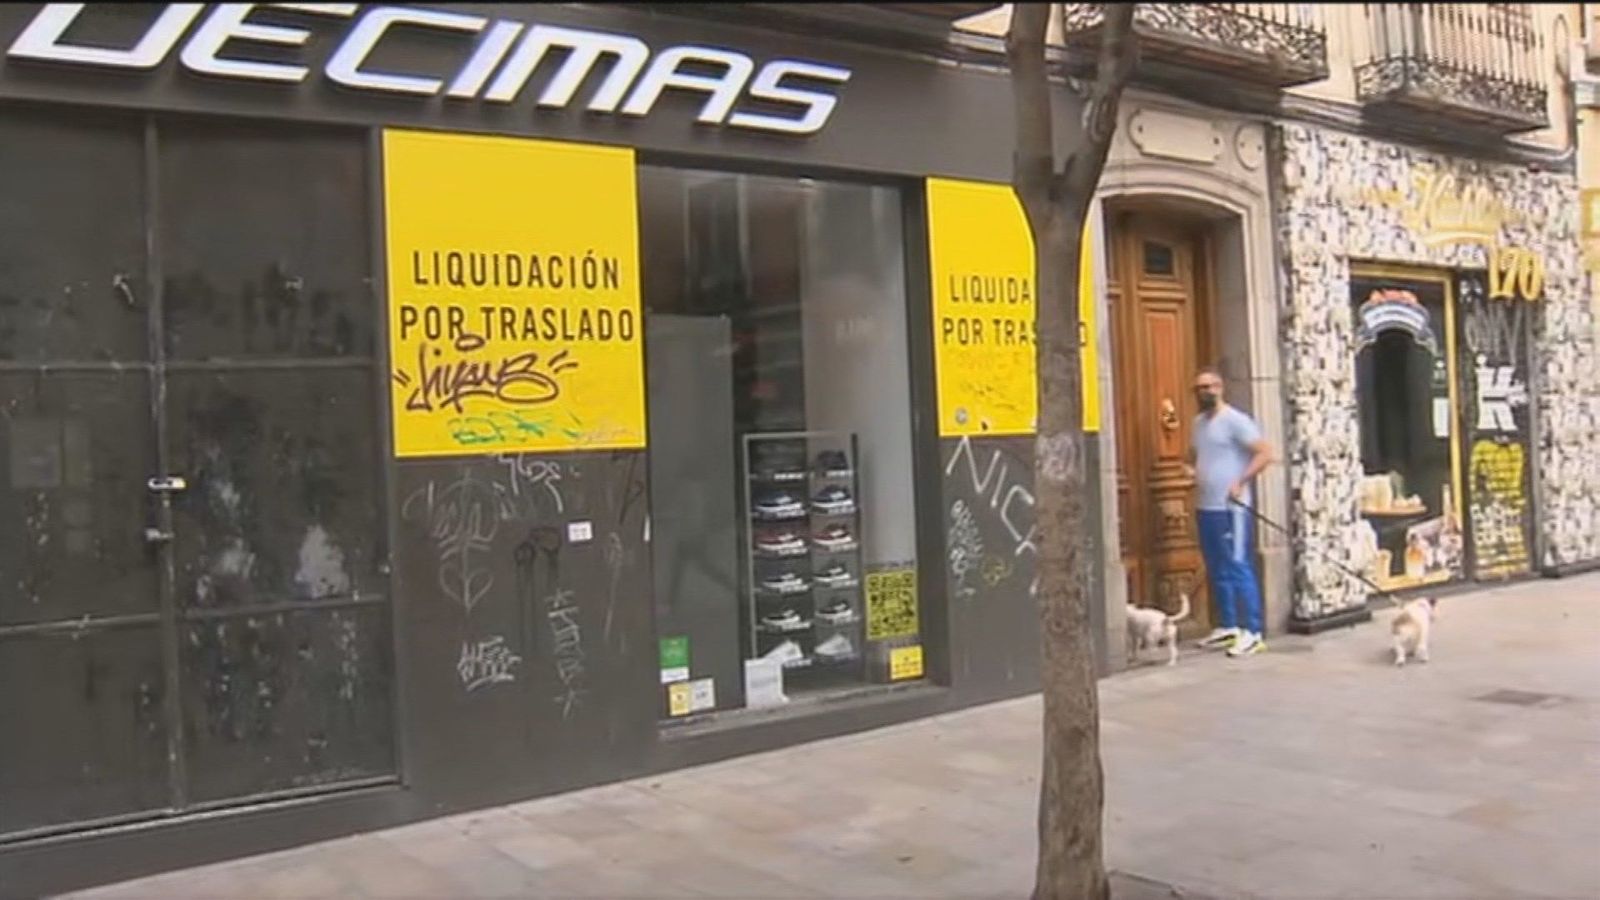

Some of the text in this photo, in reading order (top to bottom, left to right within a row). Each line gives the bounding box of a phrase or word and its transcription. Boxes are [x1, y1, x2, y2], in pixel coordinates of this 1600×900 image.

[6, 4, 851, 135] DECIMAS
[413, 250, 619, 290] LIQUIDACIÓN
[949, 275, 1032, 304] LIQUIDA
[400, 305, 635, 342] POR TRASLADO
[942, 317, 985, 346] POR
